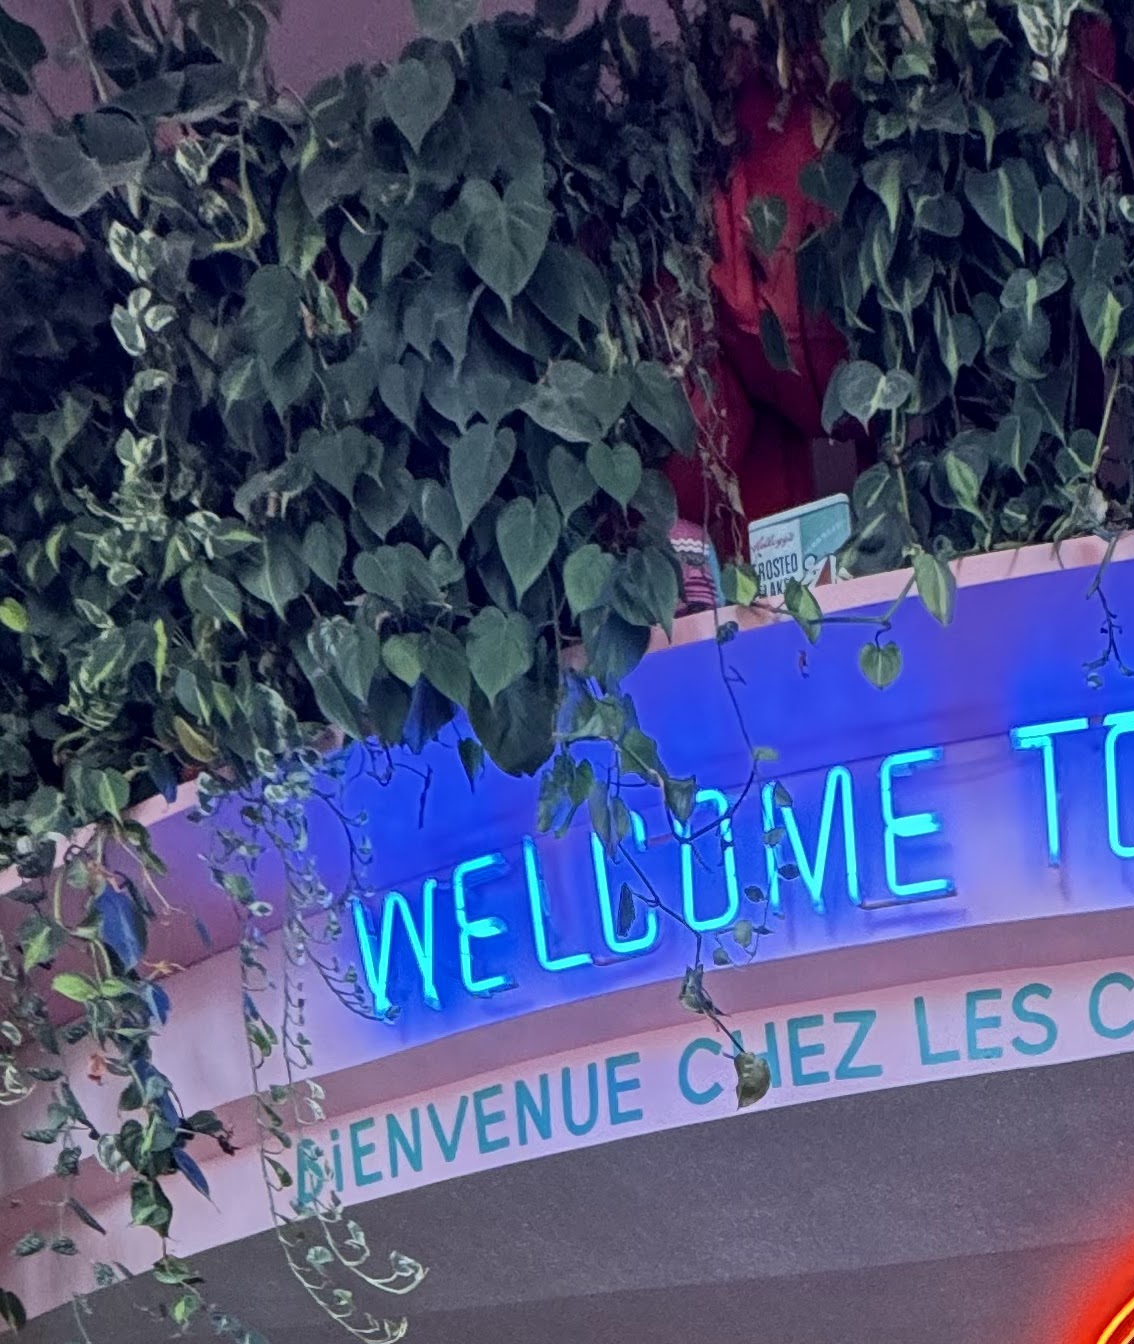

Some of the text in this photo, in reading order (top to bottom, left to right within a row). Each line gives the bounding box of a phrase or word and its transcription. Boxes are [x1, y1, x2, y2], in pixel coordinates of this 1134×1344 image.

[753, 553, 799, 583] ROSTED
[352, 746, 954, 1022] WELCOME
[678, 1010, 884, 1105] CHEZ
[913, 982, 1059, 1066] LES
